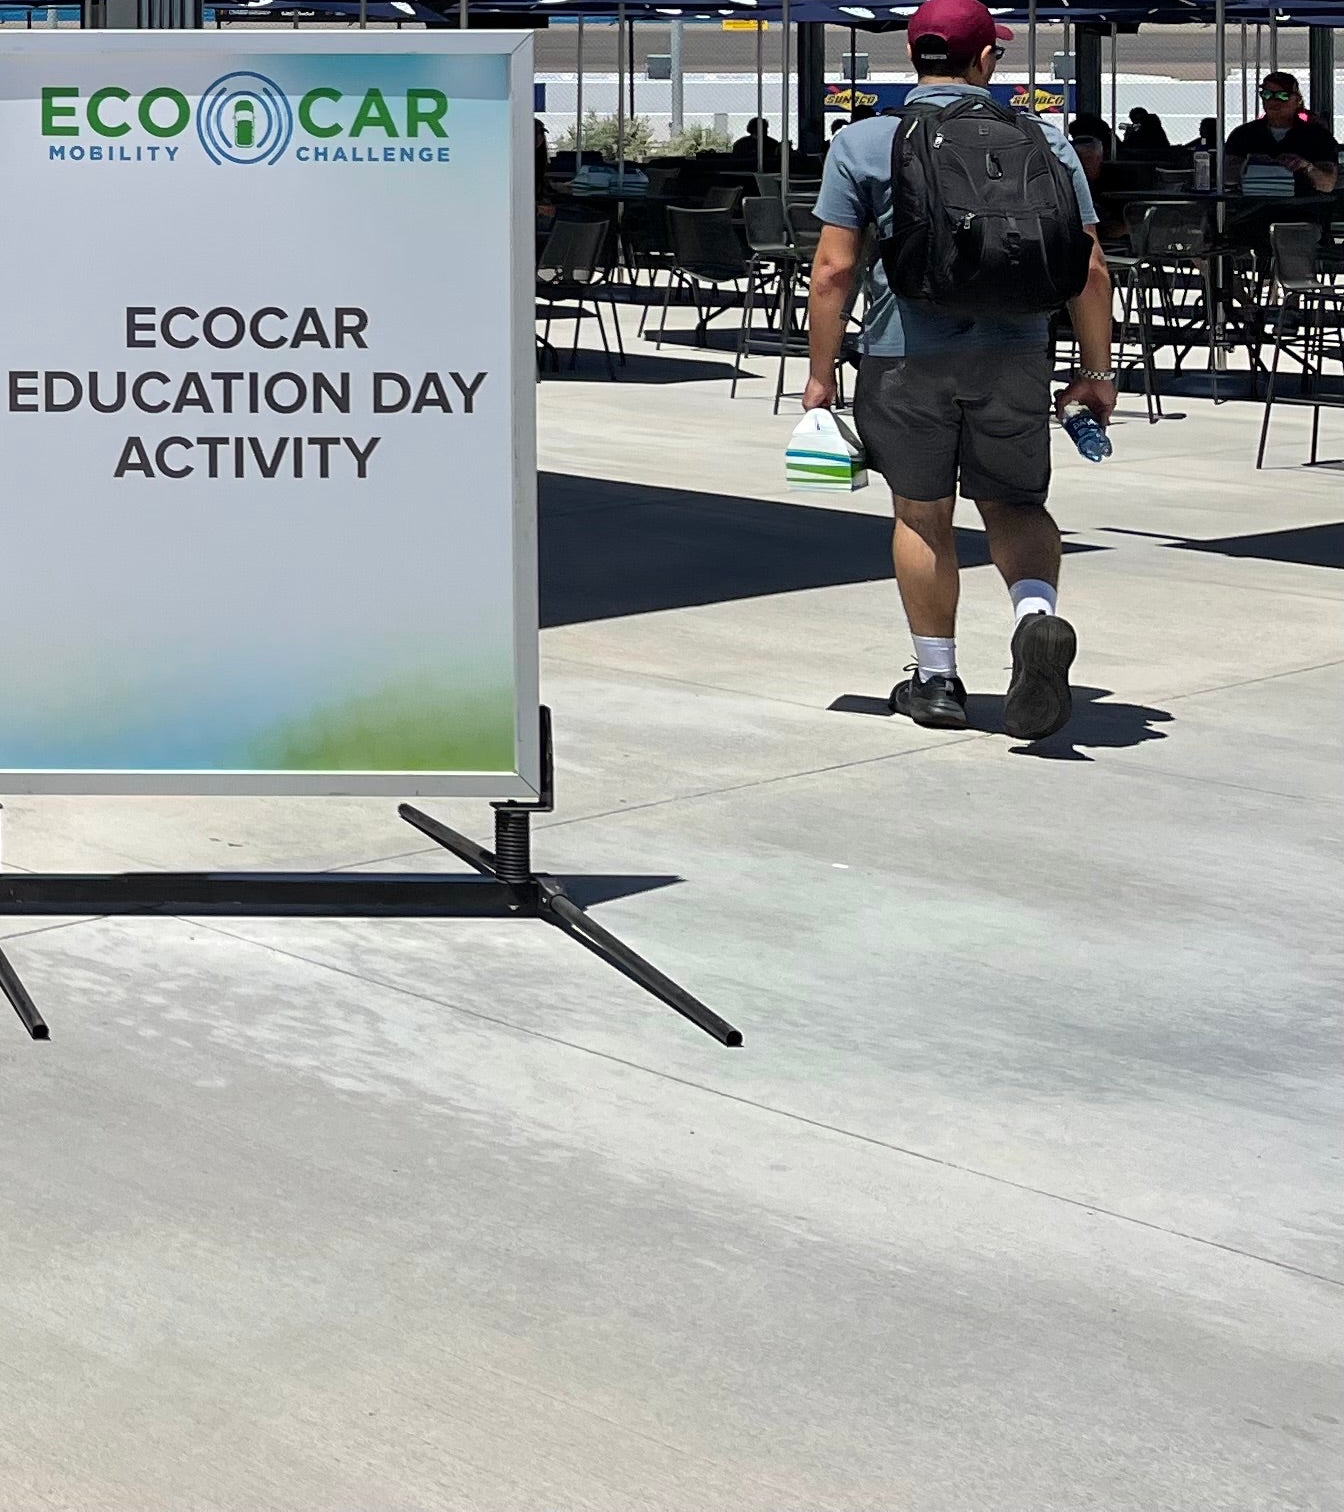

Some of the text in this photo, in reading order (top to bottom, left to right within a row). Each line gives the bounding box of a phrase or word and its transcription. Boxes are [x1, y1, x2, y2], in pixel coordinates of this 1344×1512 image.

[41, 87, 450, 138] ECO CAR
[49, 145, 451, 163] MOBILITY CHALLENGE
[125, 306, 369, 349] ECOCAR
[8, 370, 488, 414] EDUCATION DAY
[113, 436, 381, 478] ACTIVITY
